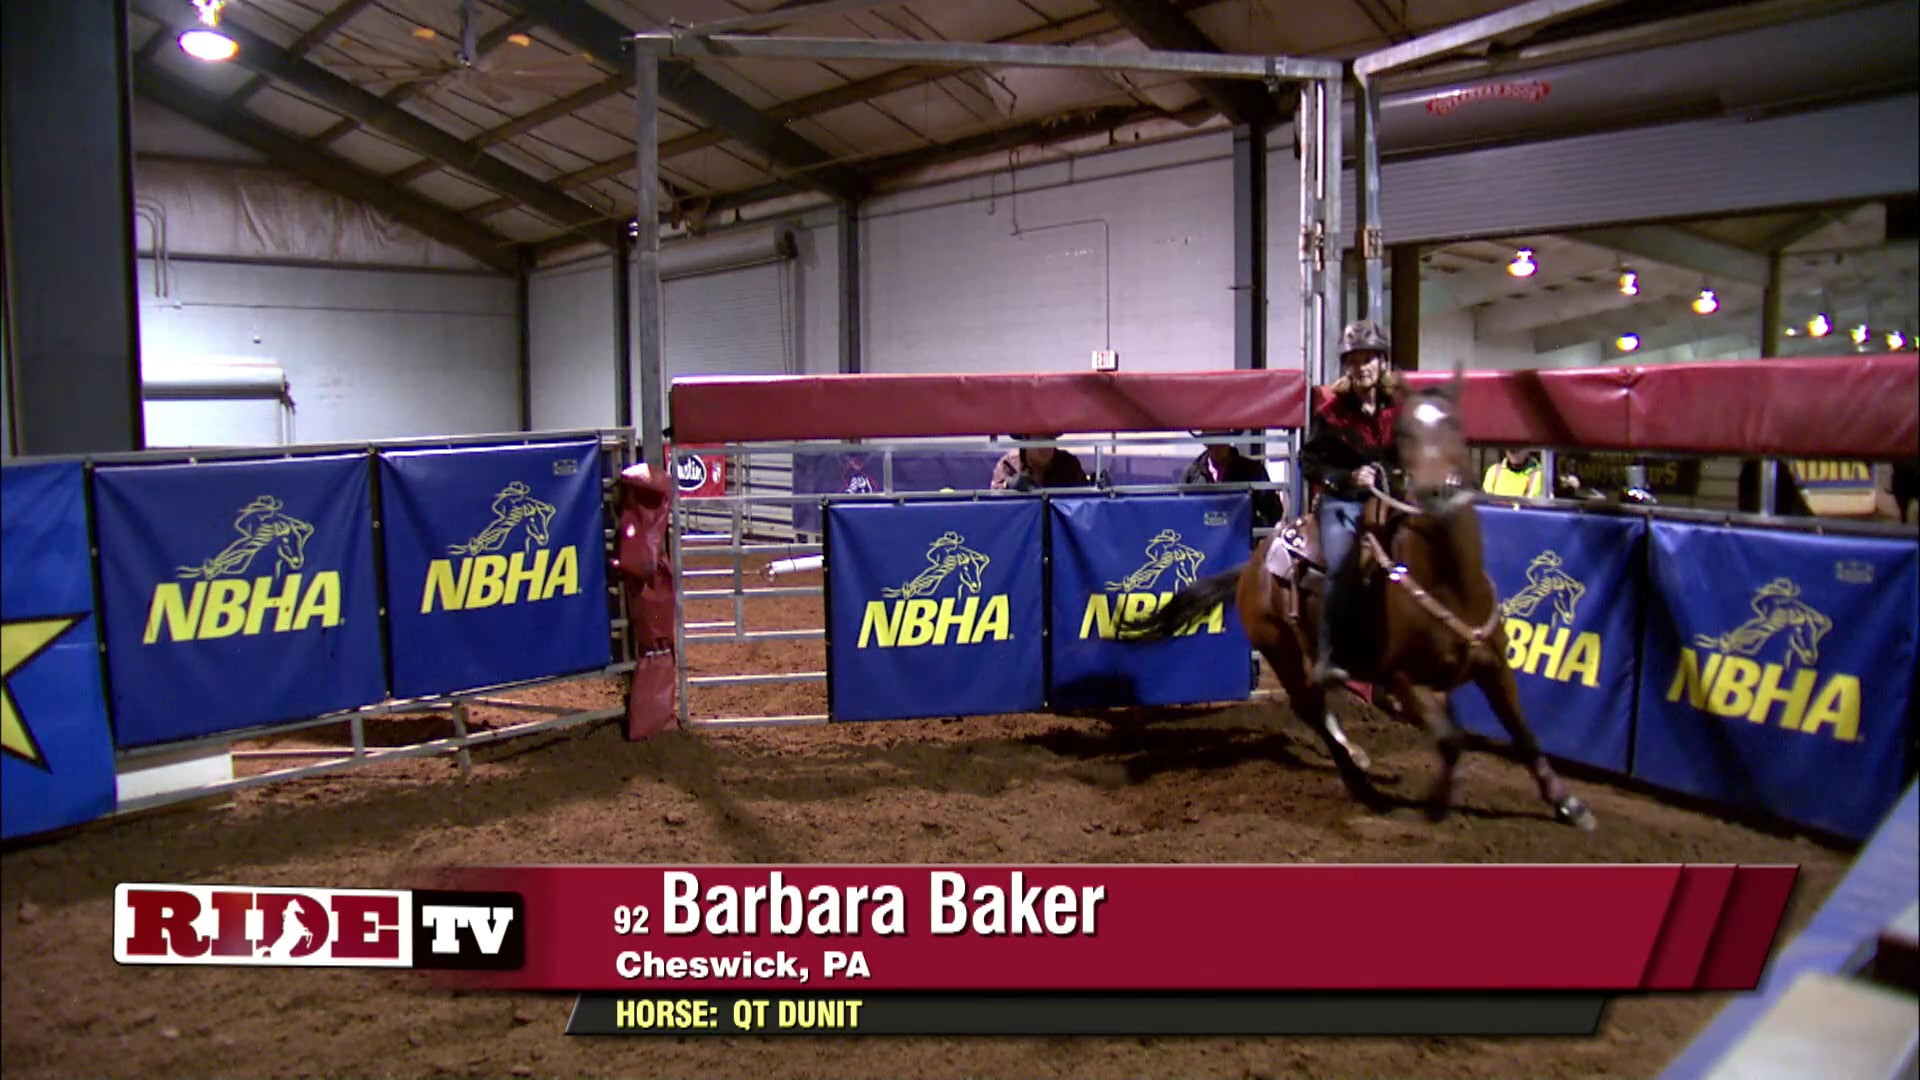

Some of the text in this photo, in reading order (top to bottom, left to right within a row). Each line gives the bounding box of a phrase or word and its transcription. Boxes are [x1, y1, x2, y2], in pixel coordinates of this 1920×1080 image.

[142, 570, 342, 645] NBHA
[421, 545, 579, 614] NBHA
[857, 594, 1011, 648] NBHA
[1503, 617, 1601, 687] BHA
[1666, 646, 1862, 742] NBHA
